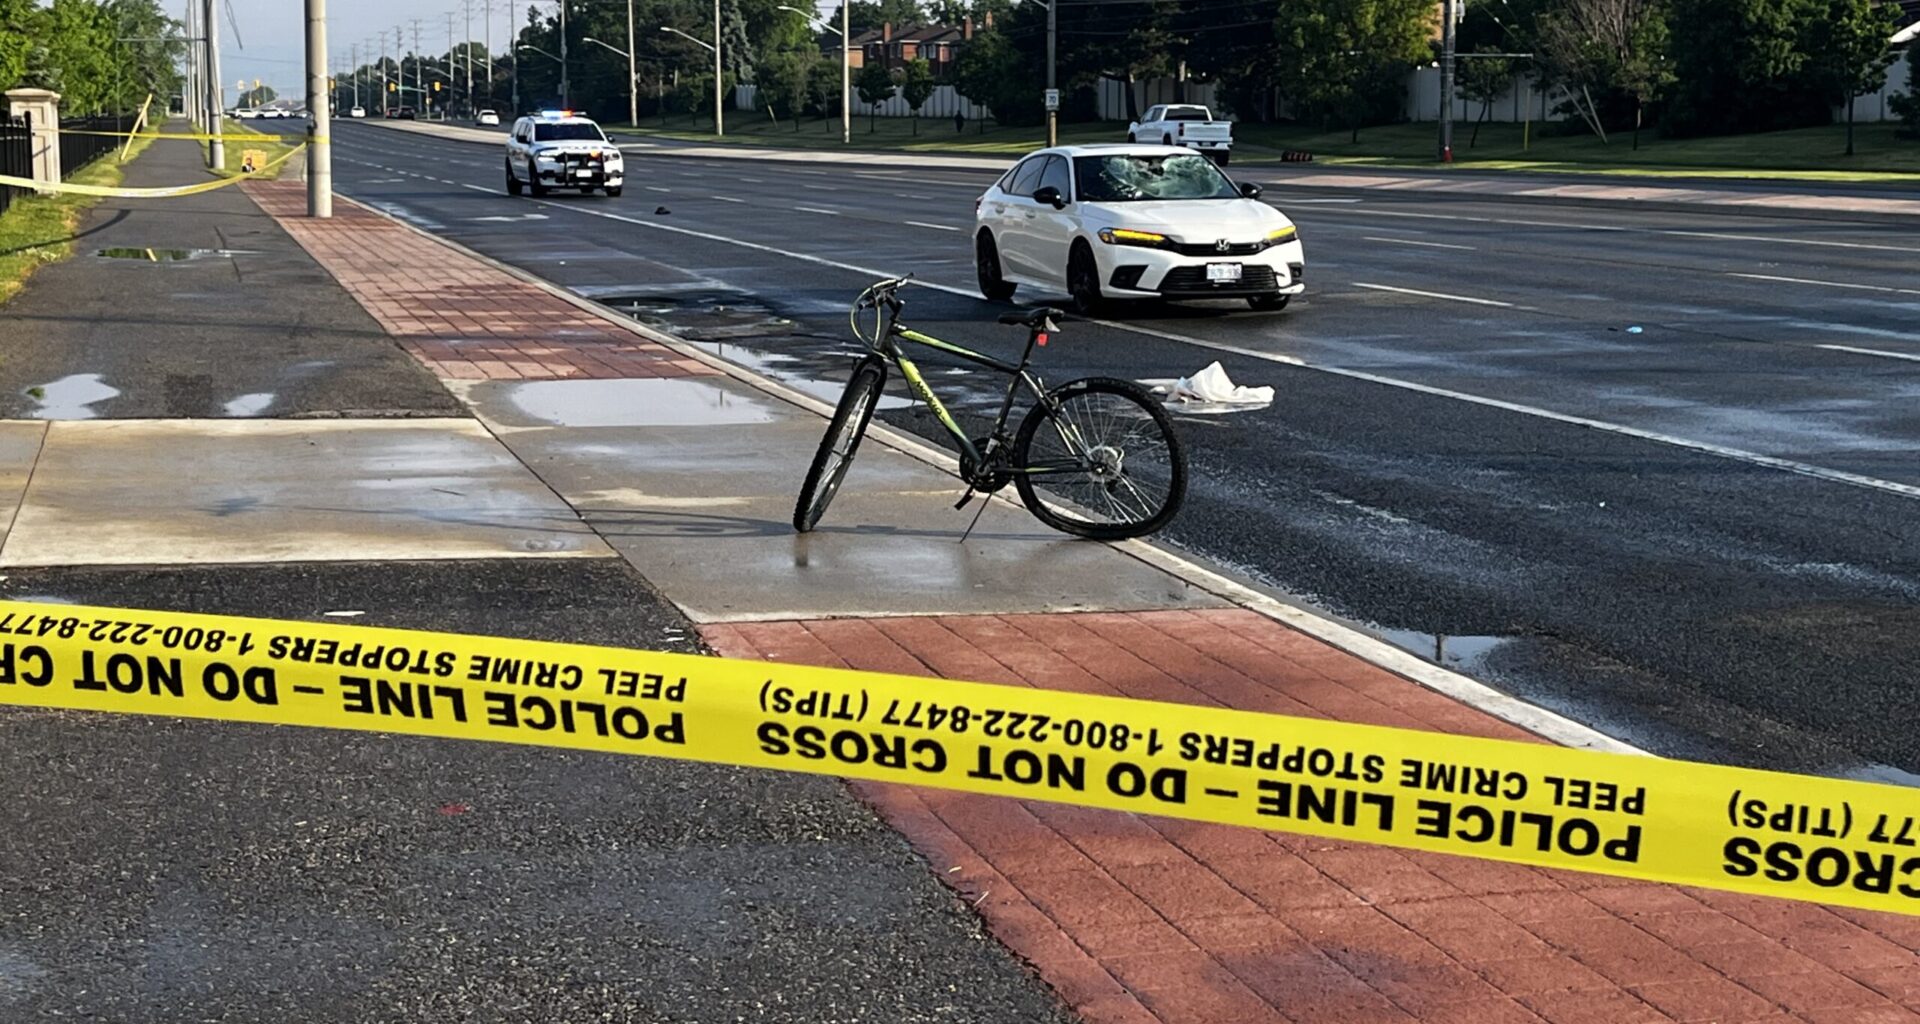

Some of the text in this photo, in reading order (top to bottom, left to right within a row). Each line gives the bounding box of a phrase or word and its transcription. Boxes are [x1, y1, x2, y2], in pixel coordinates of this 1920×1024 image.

[0, 614, 686, 702] PEEL CRIME STOPPERS 1-800-222-8477
[74, 651, 183, 697] NOT
[203, 663, 278, 705] DO
[340, 676, 467, 722] LINE
[485, 692, 685, 744] POLICE
[757, 722, 946, 772] CROSS
[760, 681, 1645, 815] PEEL CRIME STOPPERS 1-800-222-8477 (TIPS)
[968, 746, 1084, 791] NOT
[1107, 763, 1187, 803] DO
[1257, 780, 1394, 831] LINE
[1416, 800, 1641, 862] POLICE
[1729, 790, 1851, 838] (TIPS)
[1724, 837, 1920, 898] CROSS
